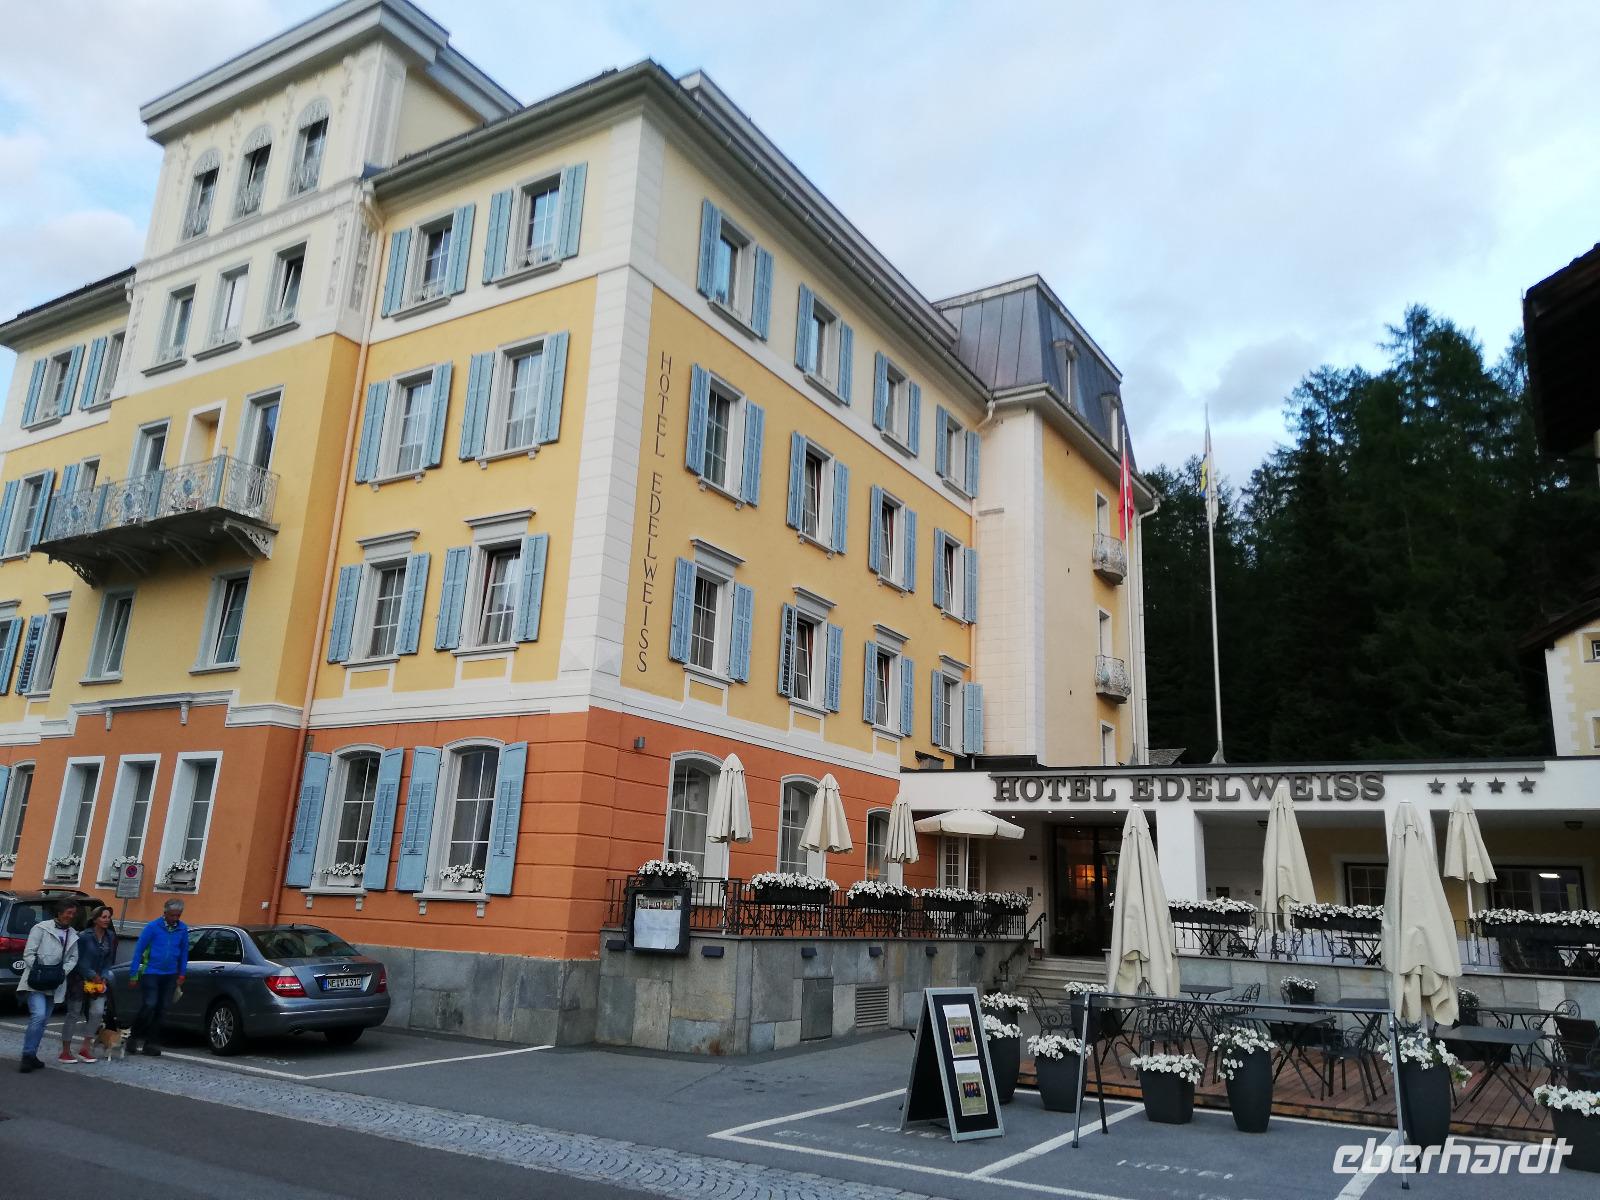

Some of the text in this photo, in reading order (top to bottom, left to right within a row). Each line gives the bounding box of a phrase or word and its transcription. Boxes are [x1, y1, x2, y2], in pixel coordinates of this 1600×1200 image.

[636, 351, 672, 673] HOTEL EDELWEISS
[991, 772, 1386, 802] HOTEL EDELWEISS
